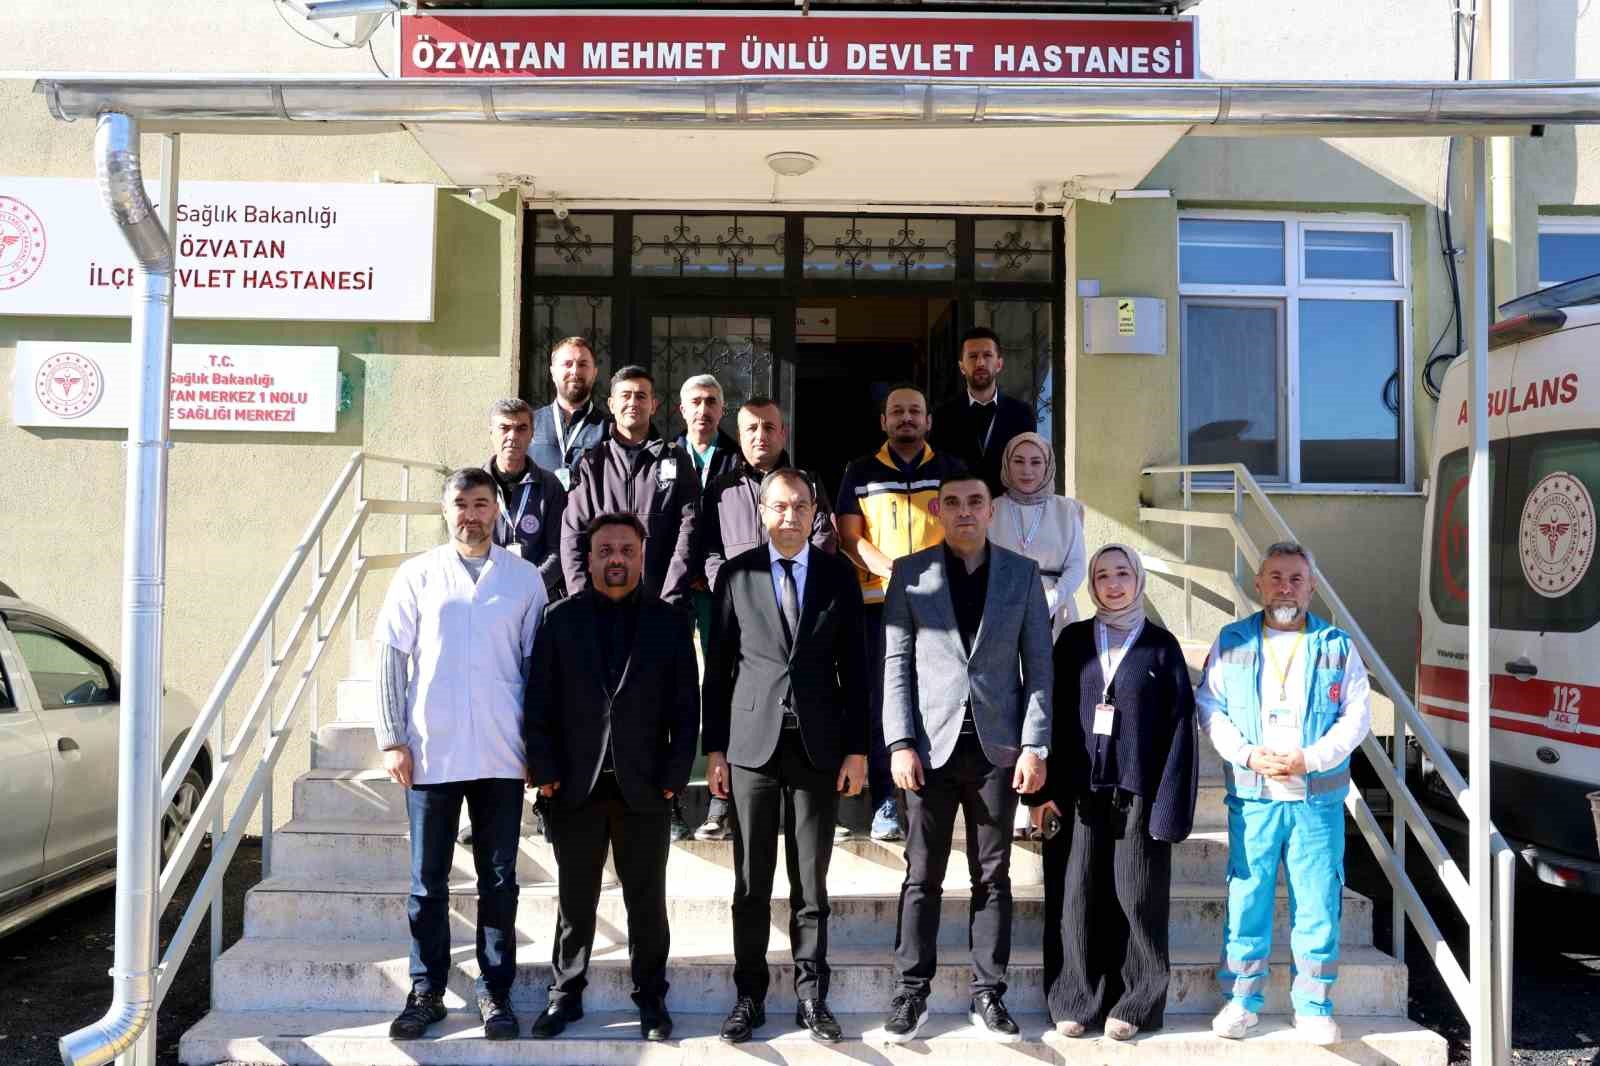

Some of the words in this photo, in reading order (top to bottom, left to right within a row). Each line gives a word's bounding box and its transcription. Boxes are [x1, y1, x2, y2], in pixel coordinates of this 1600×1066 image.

[412, 34, 565, 69] ÖZVATAN
[583, 42, 726, 69] MEHMET
[741, 35, 828, 69] ÜNLÜ
[847, 43, 974, 70] DEVLET
[994, 40, 1182, 73] HASTANESİ
[176, 204, 237, 227] Sağlık
[244, 205, 337, 228] Bakanlığı
[180, 234, 285, 258] ÖZVATAN
[243, 267, 373, 290] HASTANESİ
[209, 355, 235, 367] T.C.
[212, 373, 275, 388] Bakanlığı
[199, 390, 256, 403] MERKEZ
[259, 391, 266, 403] 1
[270, 391, 308, 404] NOLU
[177, 405, 231, 420] SAĞLIĞI
[235, 407, 296, 422] MERKEZİ
[1553, 686, 1582, 714] 112
